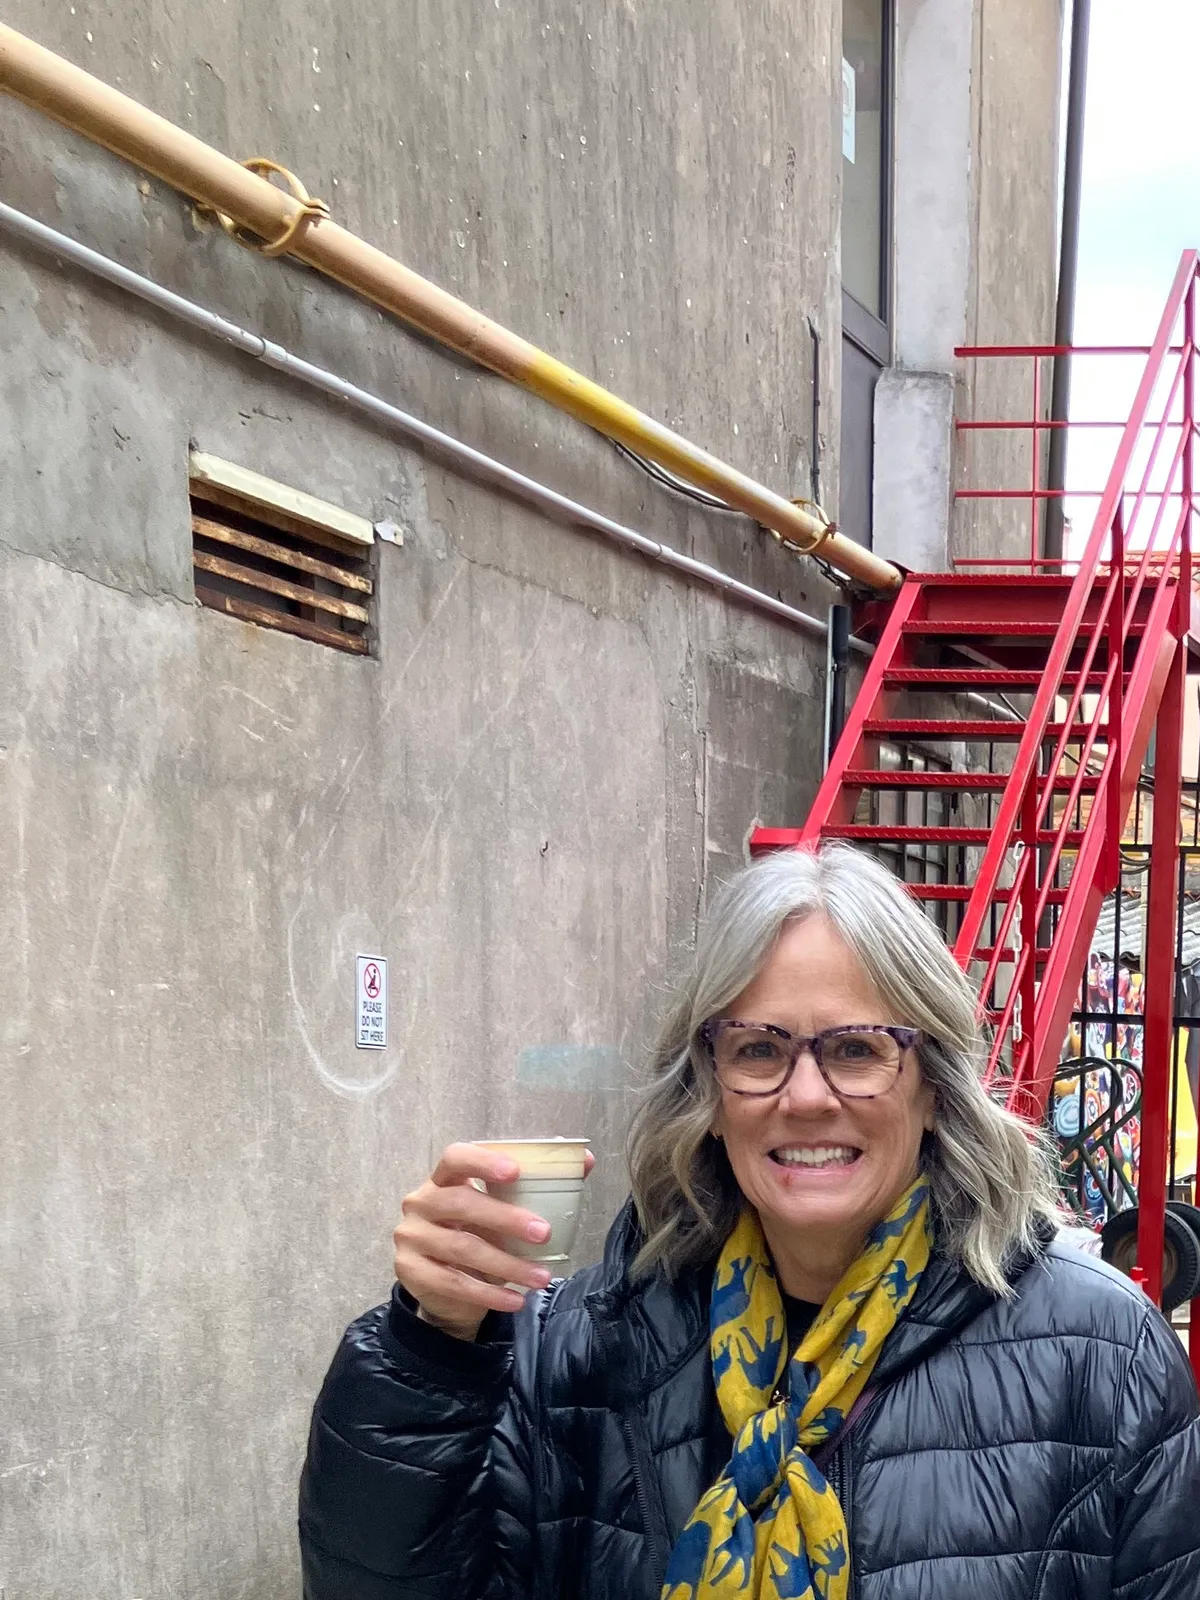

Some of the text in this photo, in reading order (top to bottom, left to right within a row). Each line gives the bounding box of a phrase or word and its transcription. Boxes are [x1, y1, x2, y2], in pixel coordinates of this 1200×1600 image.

[363, 1000, 382, 1013] PLEASE
[361, 1015, 383, 1027] DO NOT
[360, 1029, 383, 1042] SIT HERE
